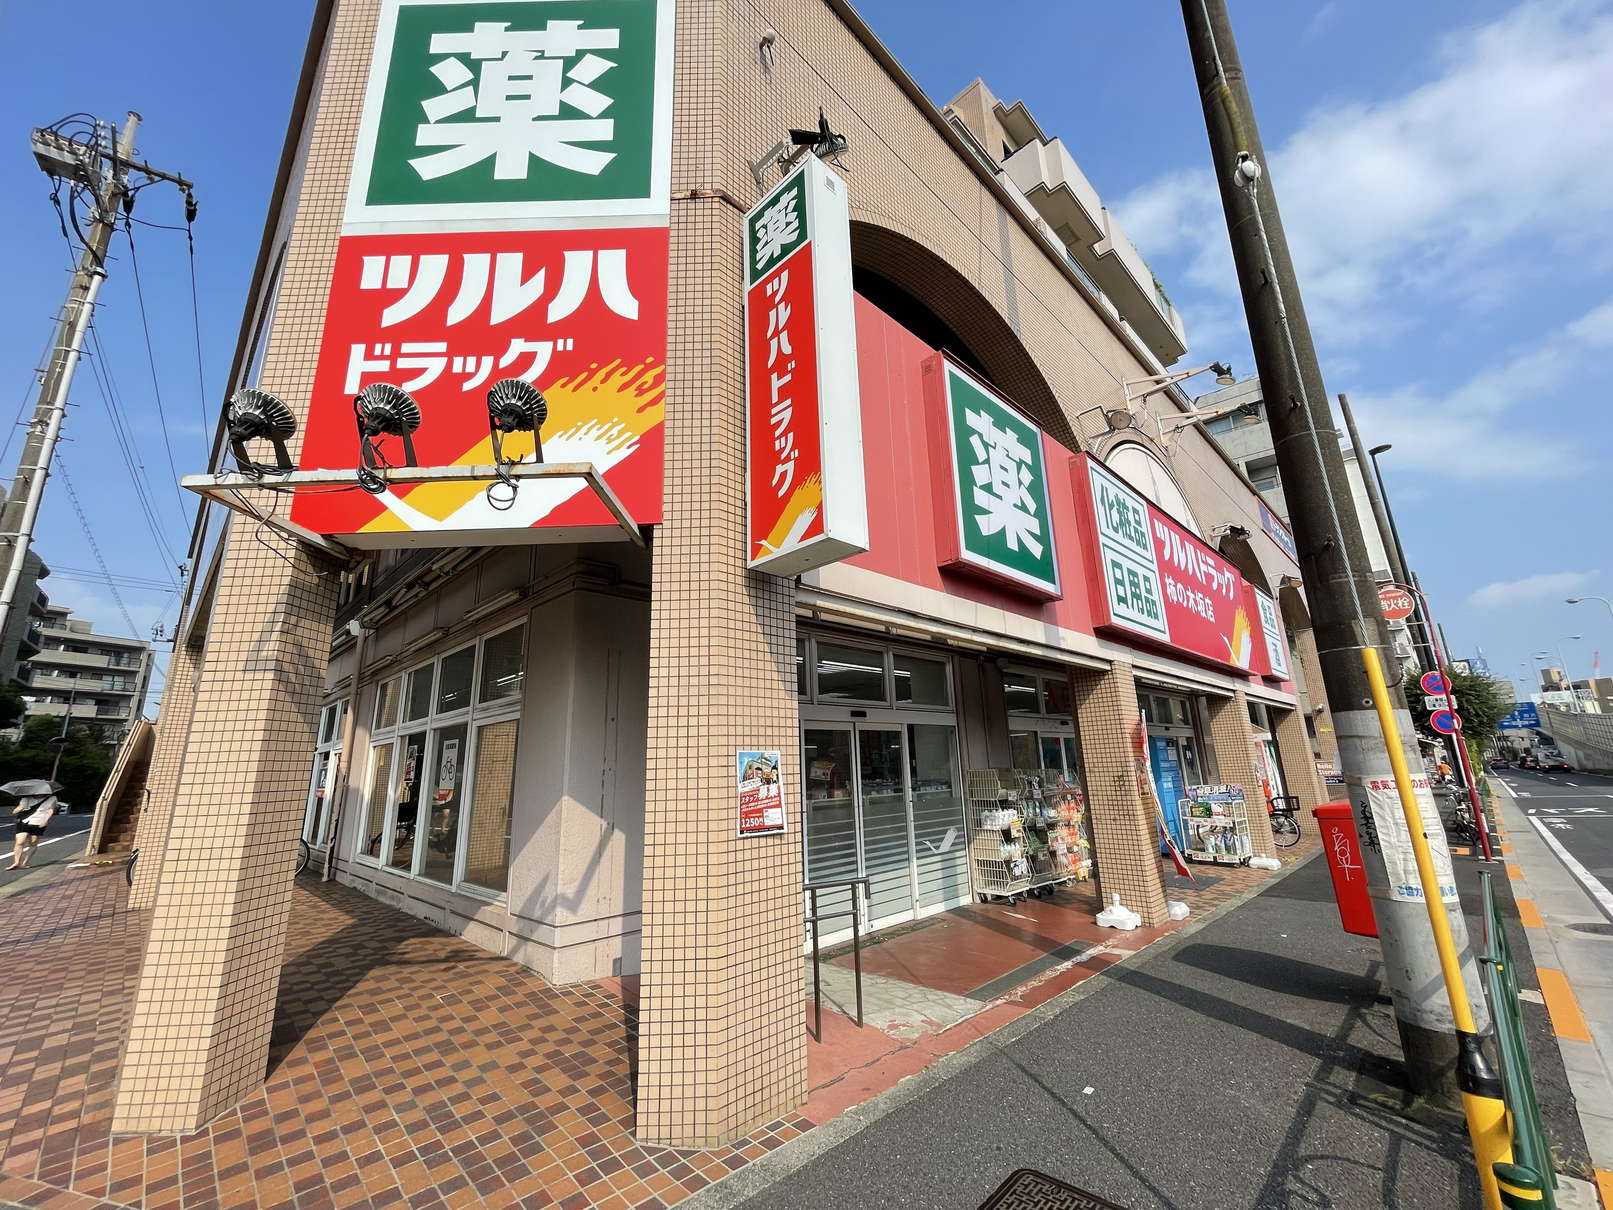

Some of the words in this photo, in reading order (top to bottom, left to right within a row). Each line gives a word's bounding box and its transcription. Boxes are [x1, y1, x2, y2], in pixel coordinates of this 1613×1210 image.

[407, 20, 620, 181] 薬
[755, 187, 800, 271] 薬
[360, 249, 639, 328] ツルハ
[344, 338, 573, 395] ドラッグ
[766, 269, 799, 498] ツルハドラッグ
[964, 407, 1044, 560] 薬
[1100, 482, 1149, 552] 化粧品
[1111, 559, 1159, 621] 日用品
[1153, 518, 1235, 600] ツルハドラッグ
[1165, 573, 1215, 623] 柿の木坂店
